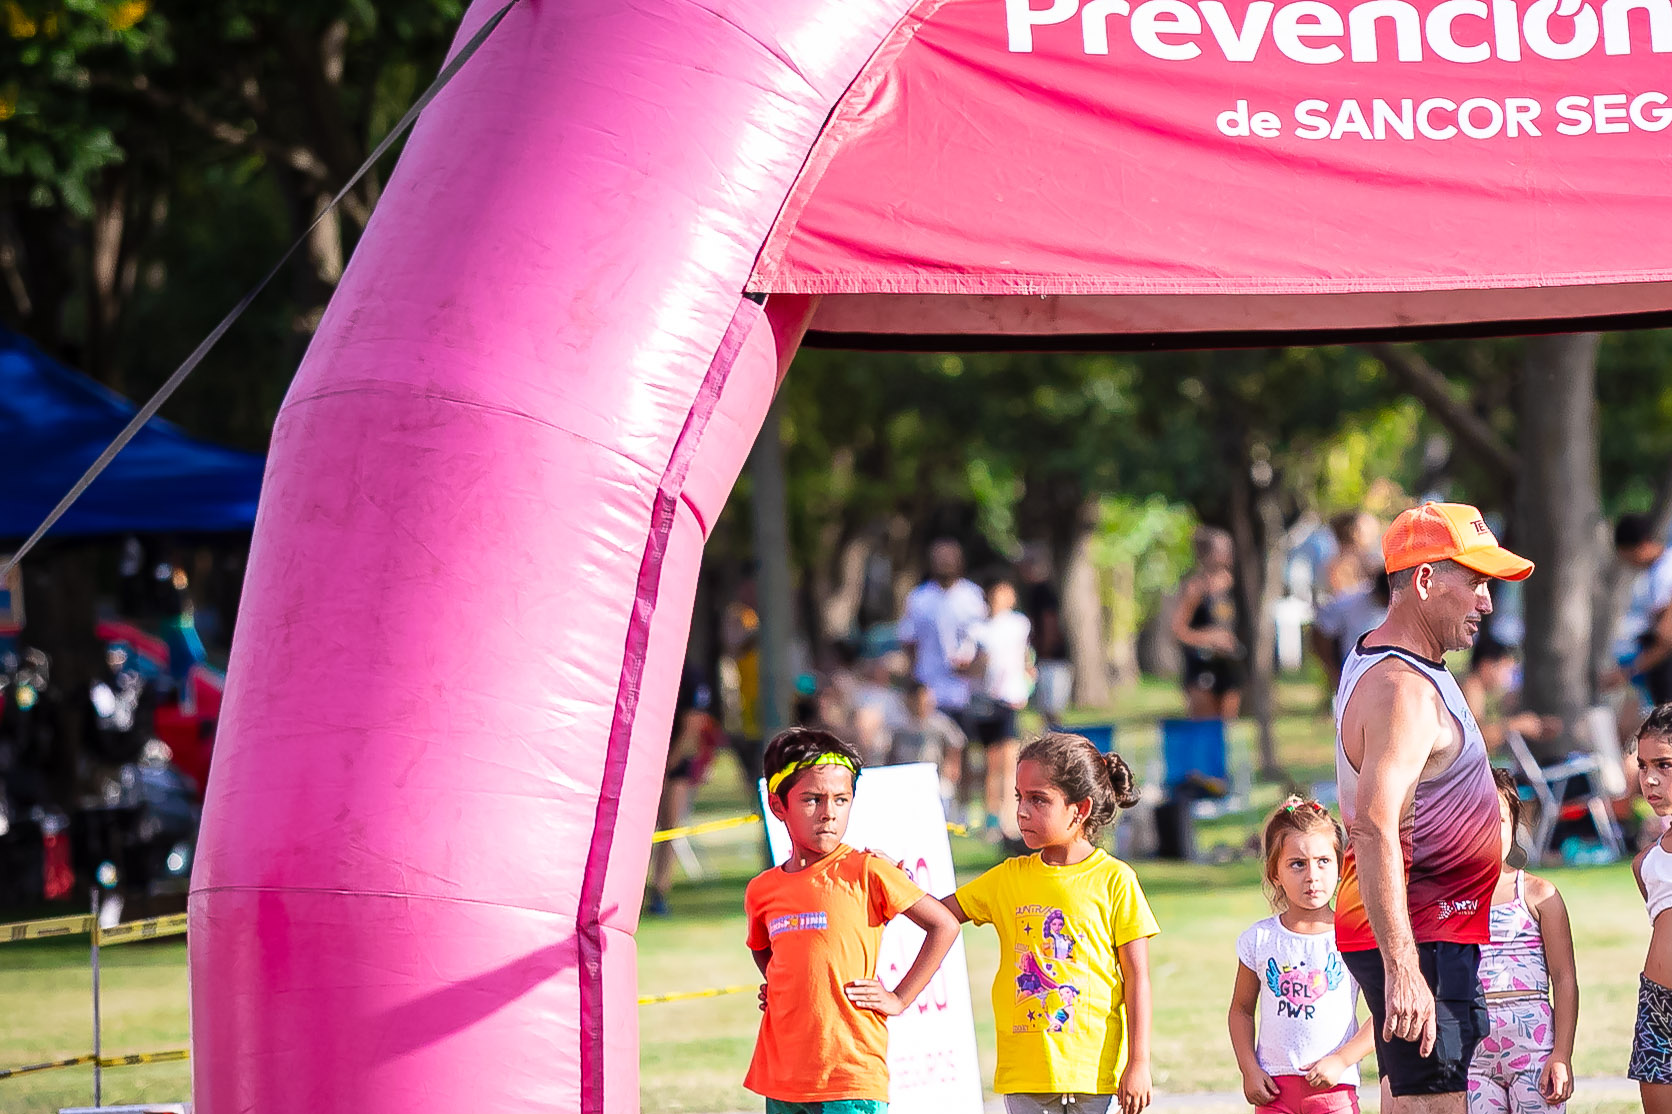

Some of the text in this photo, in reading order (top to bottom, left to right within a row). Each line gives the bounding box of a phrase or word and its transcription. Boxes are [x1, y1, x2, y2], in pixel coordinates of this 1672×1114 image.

[1216, 99, 1283, 138] de
[1293, 97, 1542, 141] SANCOR
[1280, 980, 1312, 998] GRL
[1277, 1000, 1315, 1020] PWR
